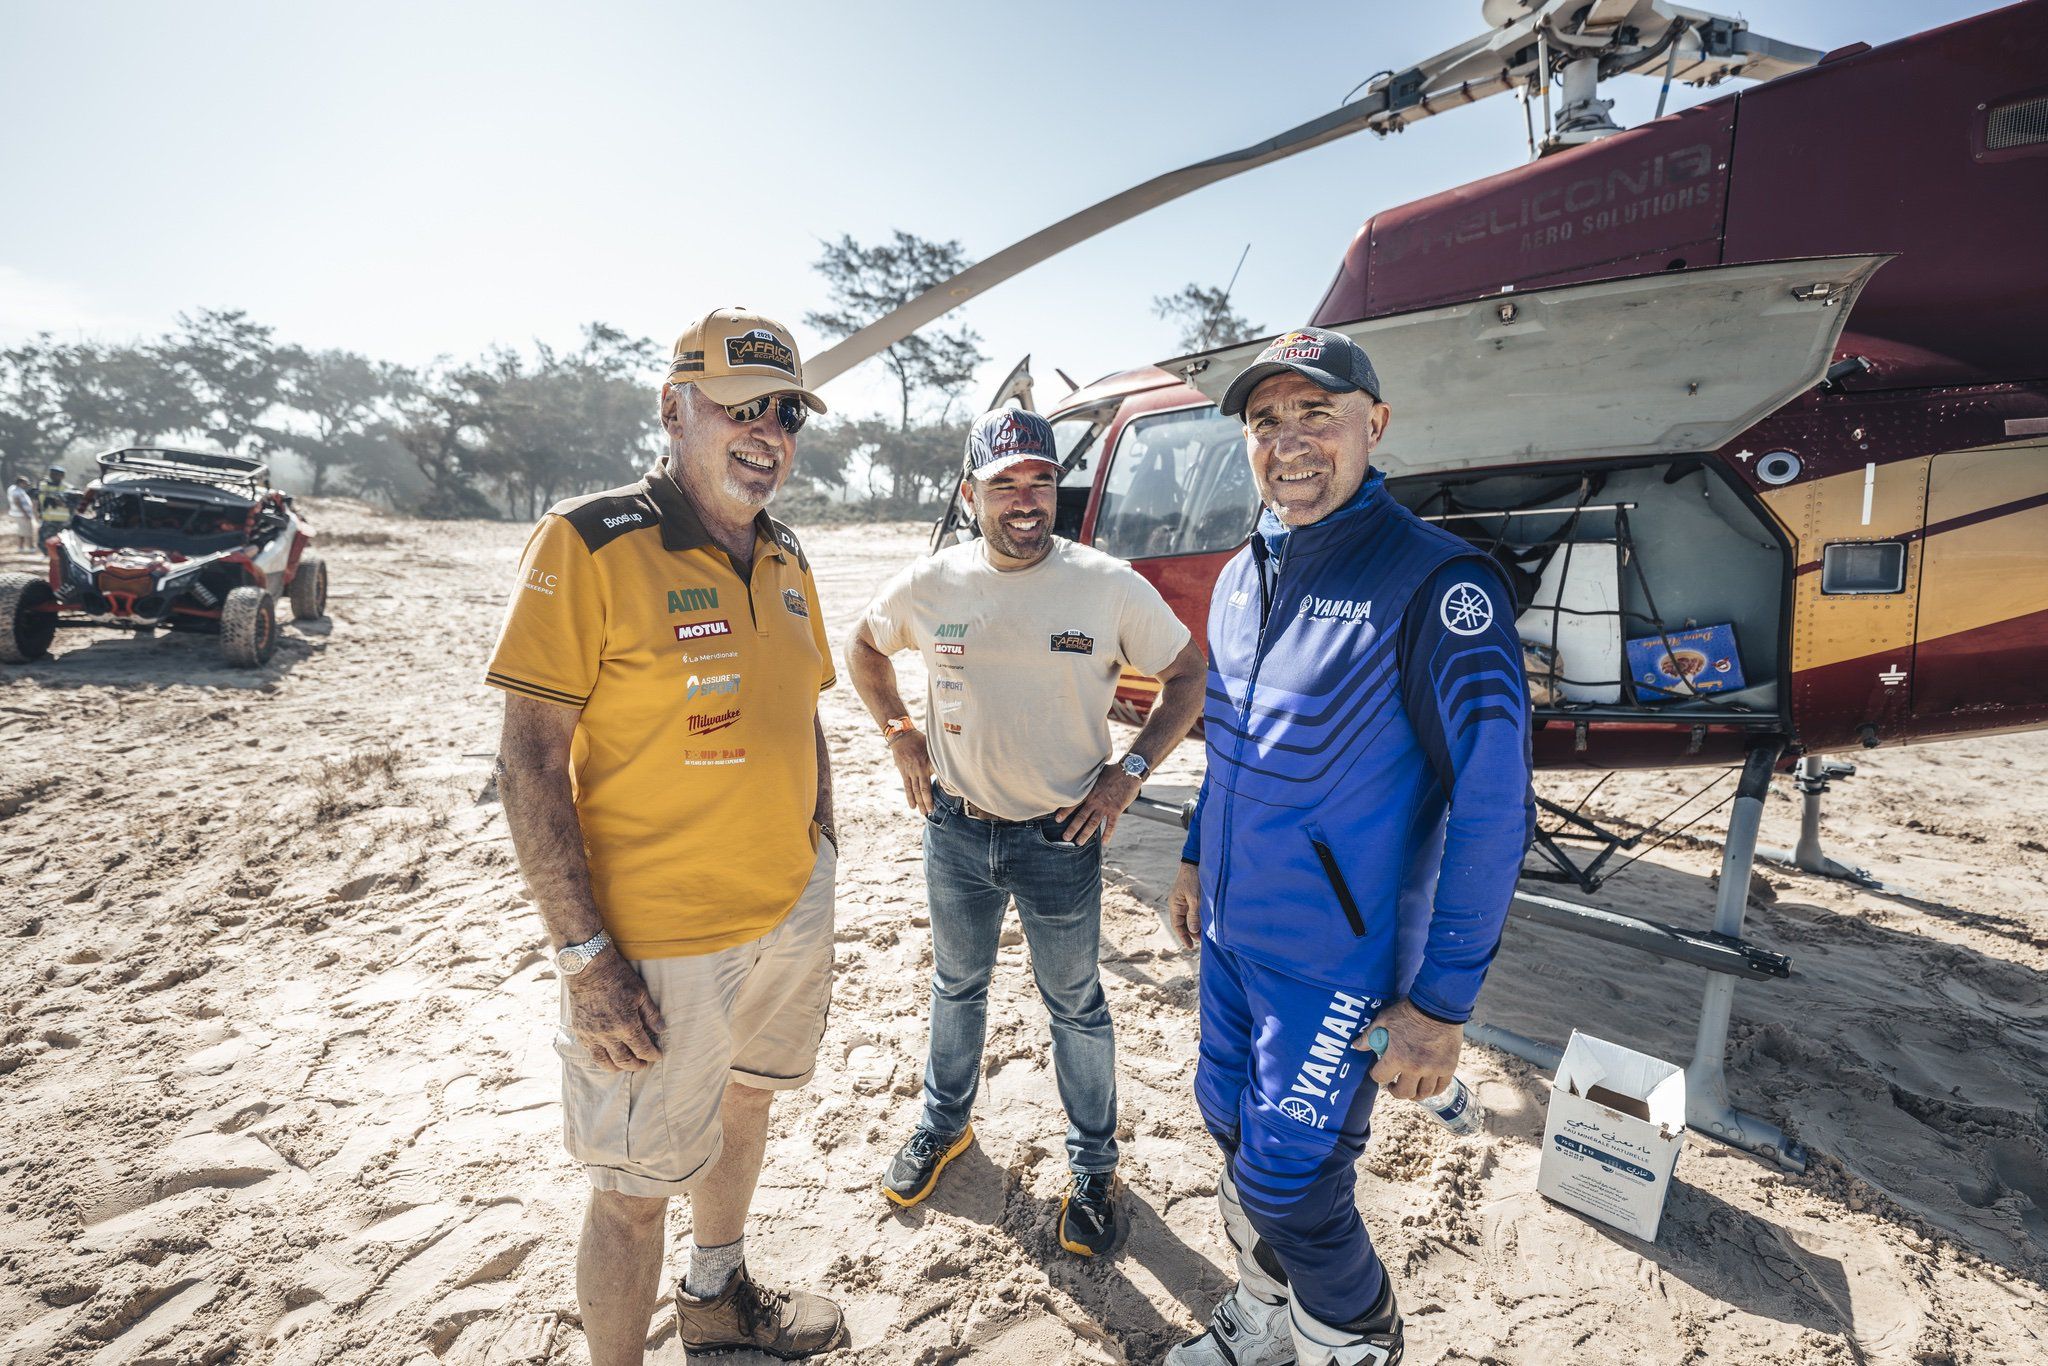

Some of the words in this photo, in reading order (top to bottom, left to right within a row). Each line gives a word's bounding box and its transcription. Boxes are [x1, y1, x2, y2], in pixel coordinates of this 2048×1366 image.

[1521, 221, 1573, 252] AERO
[1583, 183, 1711, 235] SOLUTIONS
[739, 340, 793, 363] AFRICA
[1285, 347, 1321, 360] Bull
[667, 587, 719, 614] AMV
[1313, 597, 1372, 619] YAMAHA
[1297, 613, 1362, 625] RACING
[678, 621, 729, 640] MOTUL
[934, 623, 969, 638] AMV
[936, 644, 963, 654] MOTUL
[1057, 636, 1093, 647] AFRICA
[700, 680, 741, 697] SPORT
[701, 674, 731, 685] ASSURE
[942, 681, 964, 691] SPORT
[686, 708, 741, 732] Milwaukee
[1291, 990, 1370, 1098] YAMAH
[1563, 1126, 1577, 1135] EAU
[1611, 1145, 1649, 1163] NATURELLE
